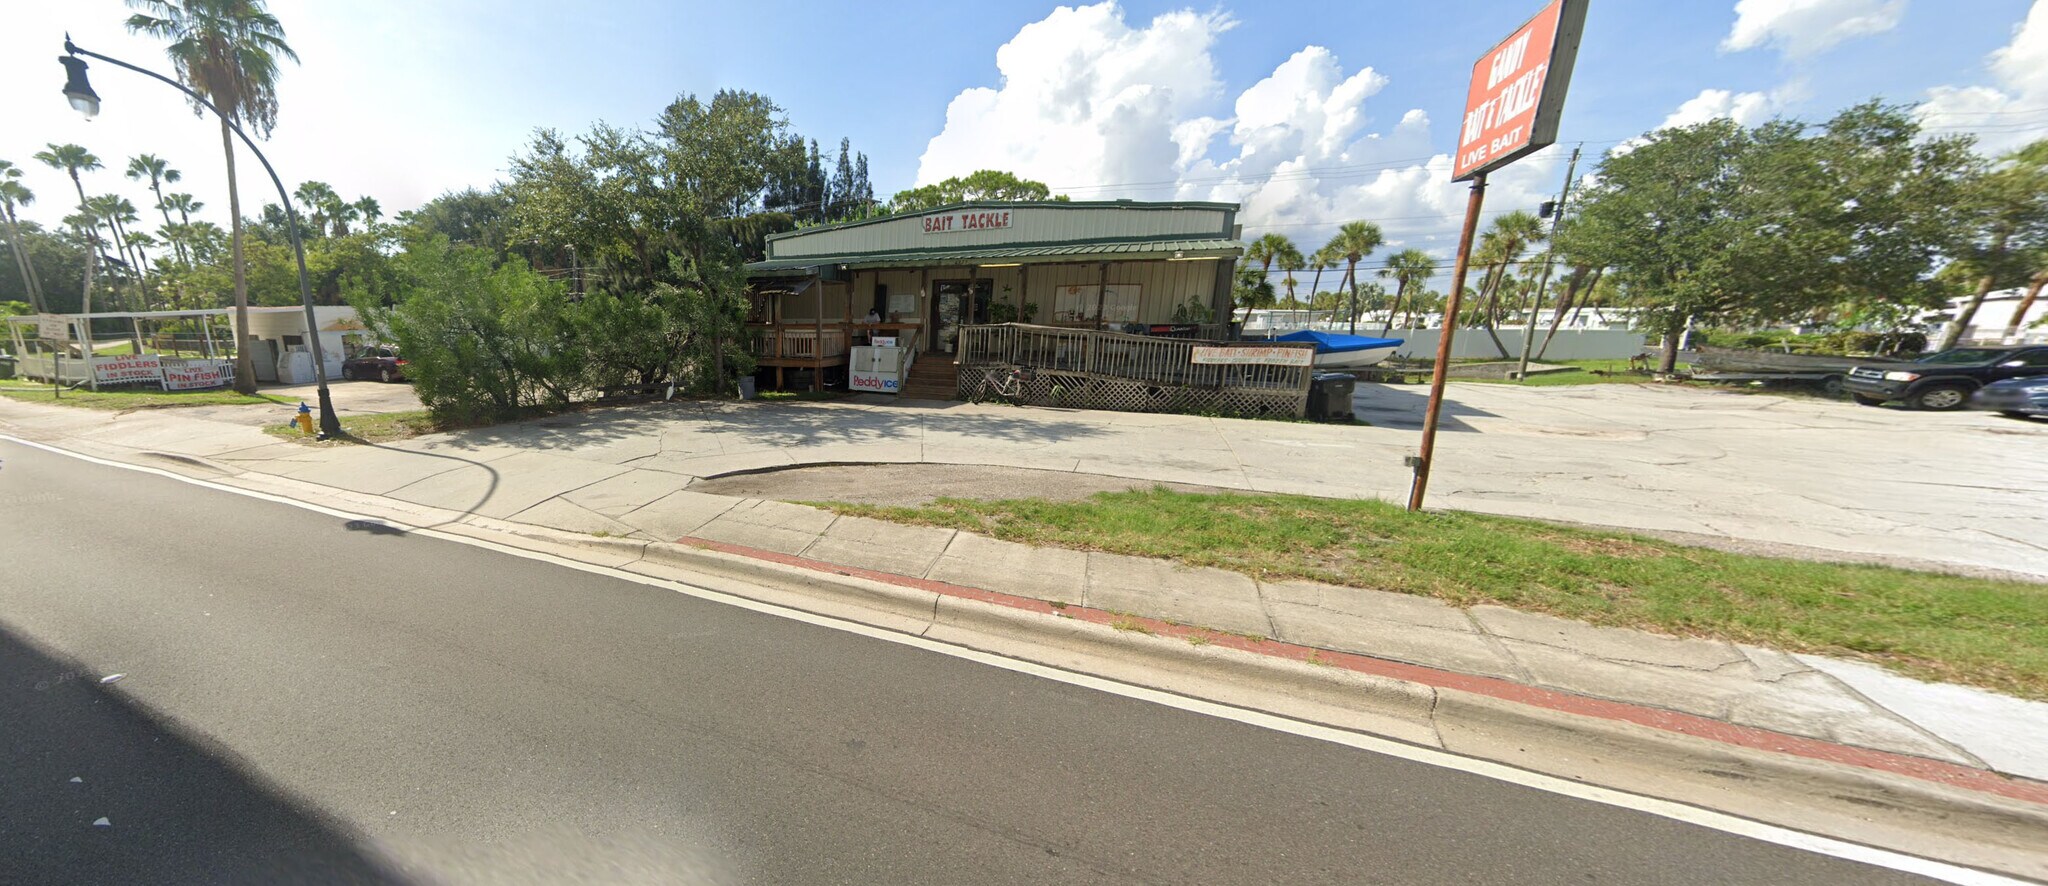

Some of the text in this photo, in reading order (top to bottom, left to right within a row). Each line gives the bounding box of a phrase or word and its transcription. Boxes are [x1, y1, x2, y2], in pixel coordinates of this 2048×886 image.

[1462, 98, 1489, 147] BAIT
[1495, 63, 1546, 129] TACKLE
[1461, 125, 1524, 169] LIVE BAIT
[962, 212, 1009, 230] TACKLE
[115, 354, 138, 362] LIVE
[1201, 348, 1218, 357] LIVE
[1219, 348, 1237, 357] BAIT
[1241, 348, 1272, 357] SHRIMP
[96, 360, 158, 372] FIDDLERS
[169, 371, 220, 382] PIN FISH
